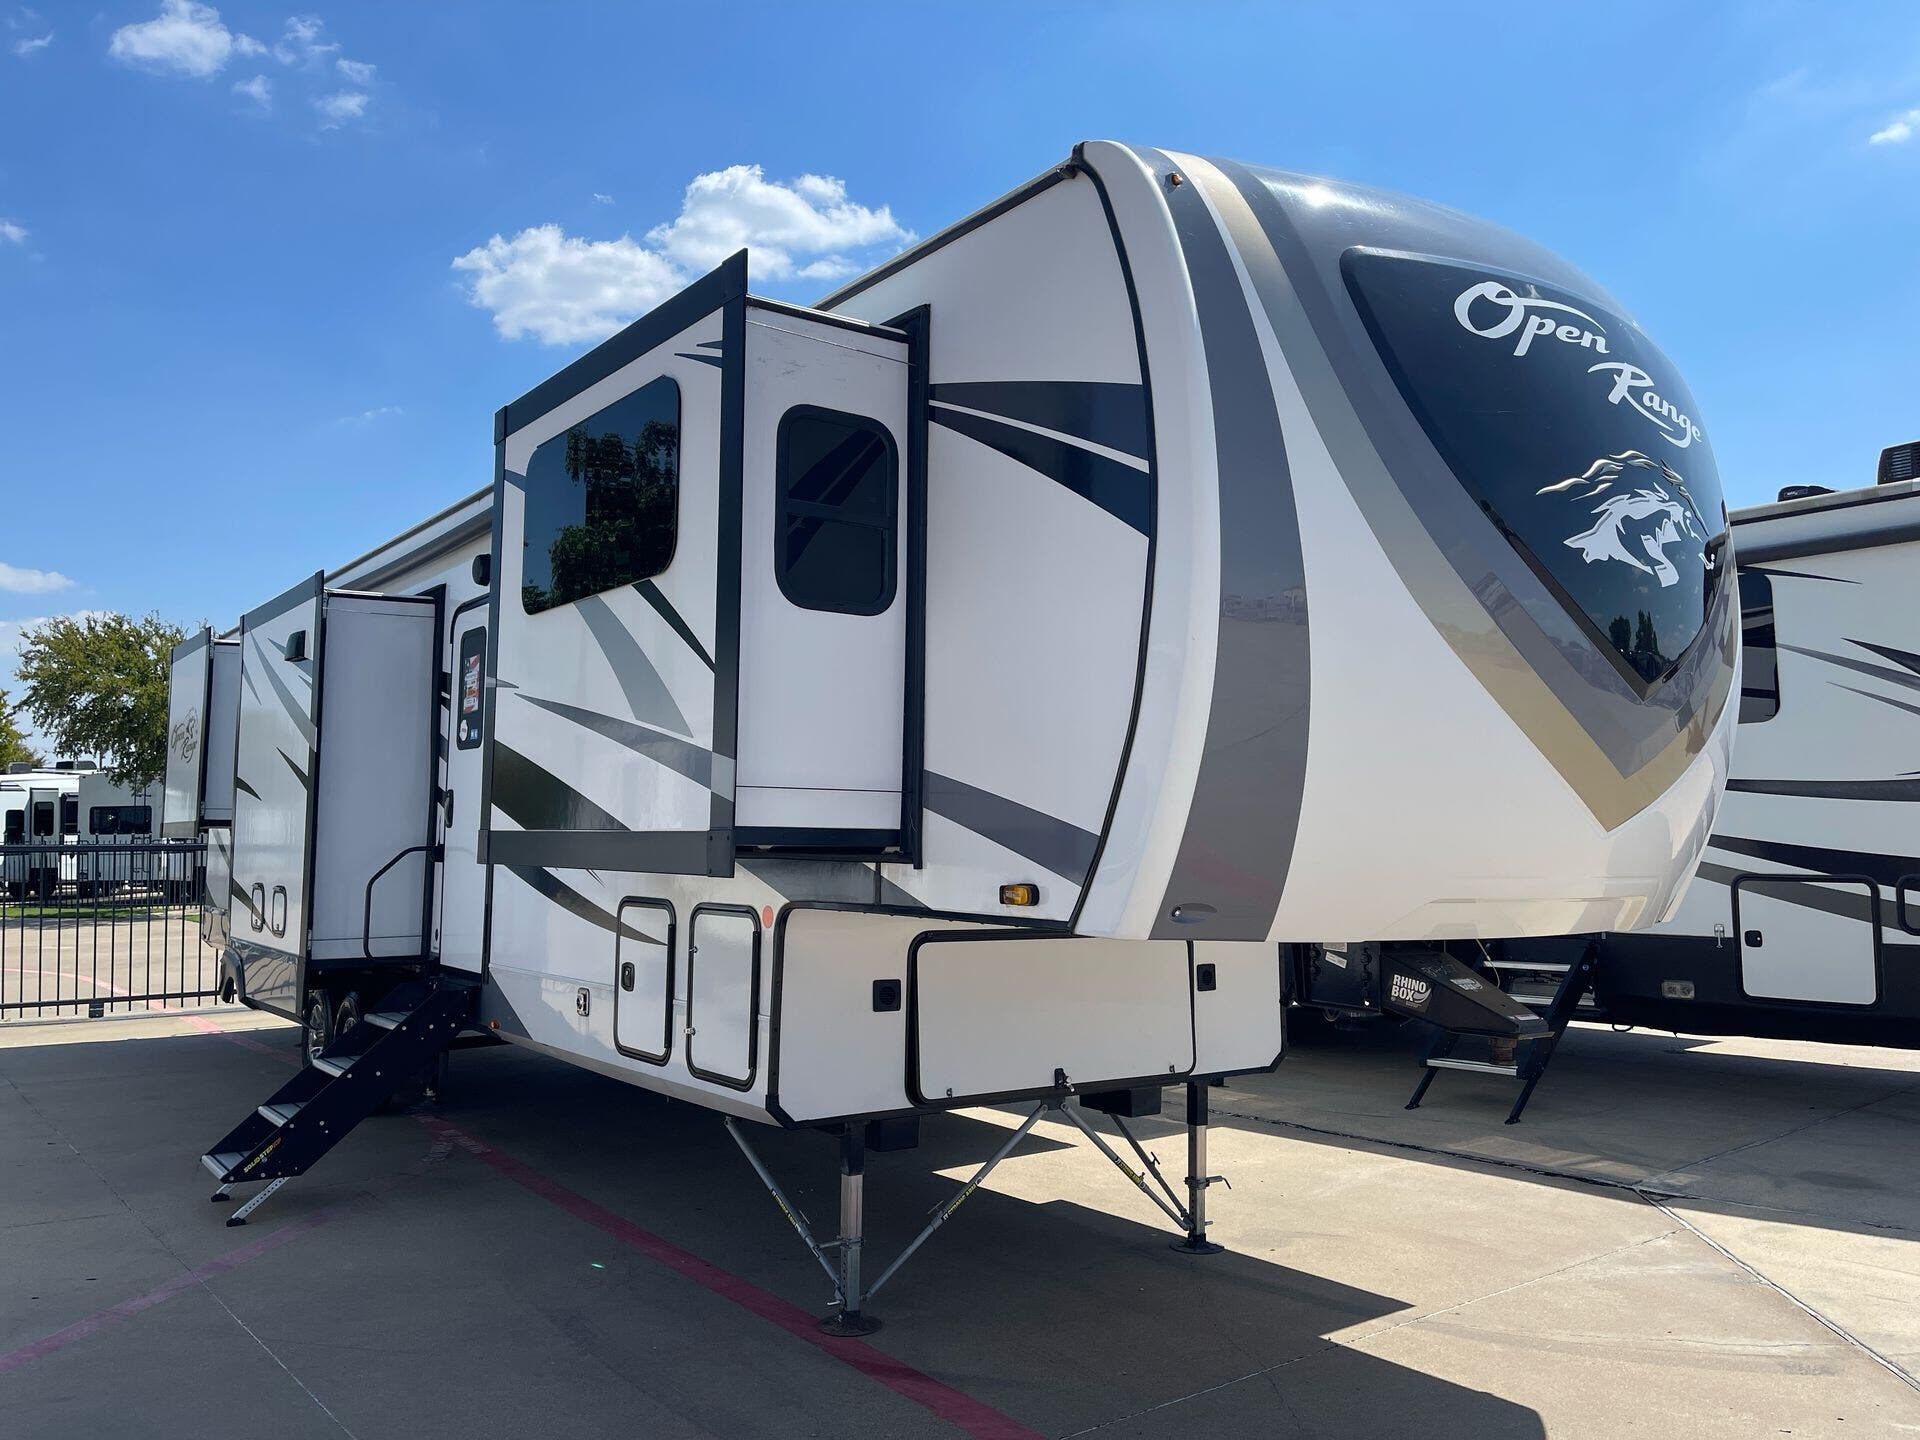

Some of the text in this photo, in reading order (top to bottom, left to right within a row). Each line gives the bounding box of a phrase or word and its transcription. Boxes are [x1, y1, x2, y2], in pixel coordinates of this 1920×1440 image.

[1454, 281, 1610, 356] Open
[1588, 361, 1702, 448] Range
[1391, 985, 1416, 1002] BOX
[1393, 973, 1427, 993] RHINO
